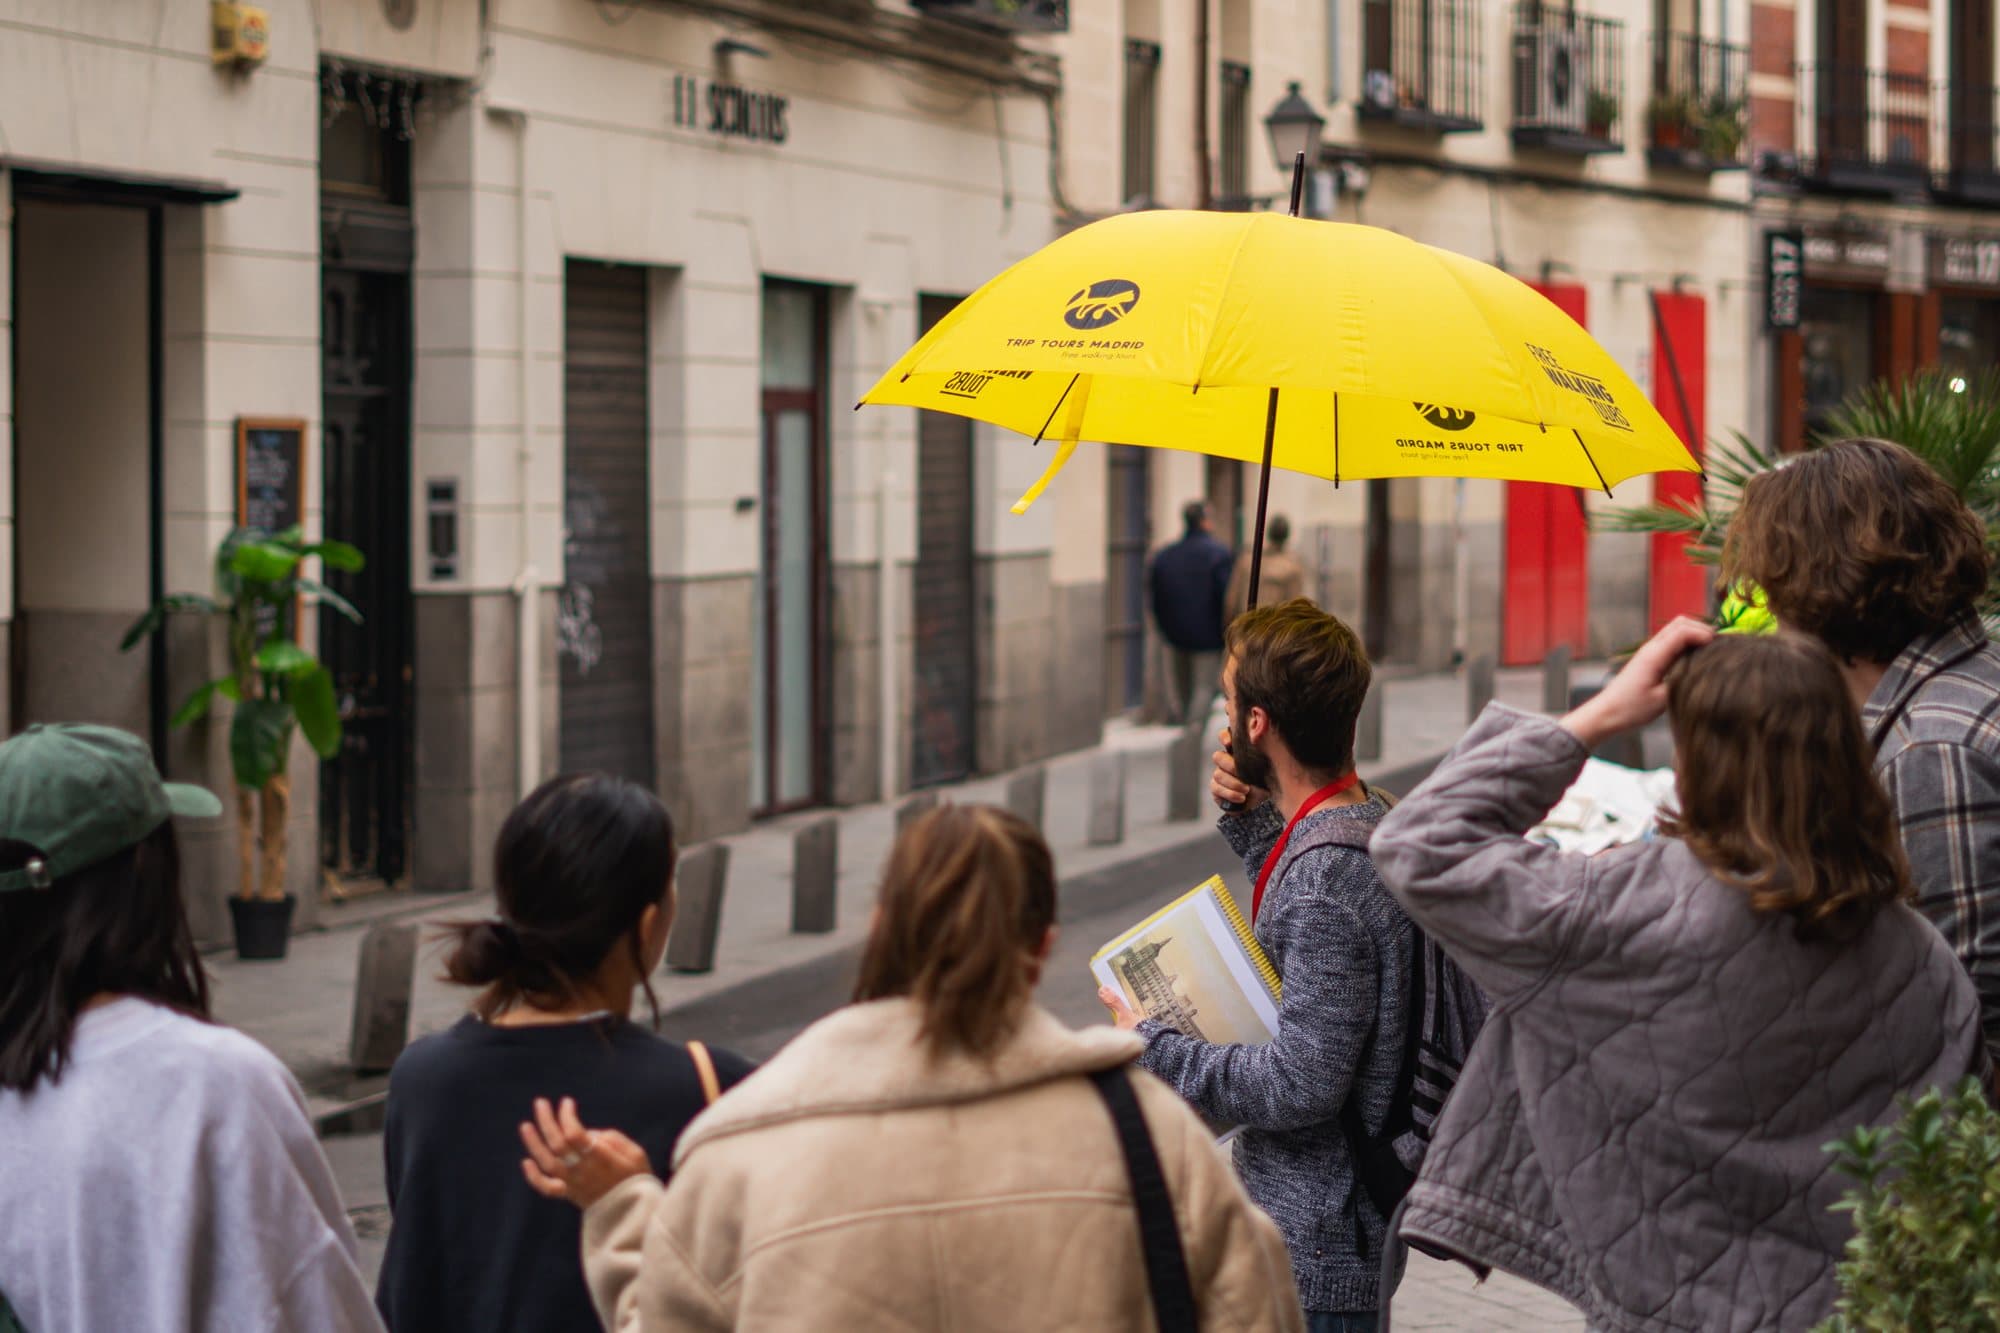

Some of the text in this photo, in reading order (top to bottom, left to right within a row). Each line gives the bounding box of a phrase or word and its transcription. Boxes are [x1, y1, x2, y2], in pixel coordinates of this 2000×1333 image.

[1006, 338, 1145, 350] TRIP TOURS MADRID
[1525, 342, 1563, 370] FREE
[1542, 366, 1615, 404] WALKING
[1586, 398, 1631, 427] TOURS
